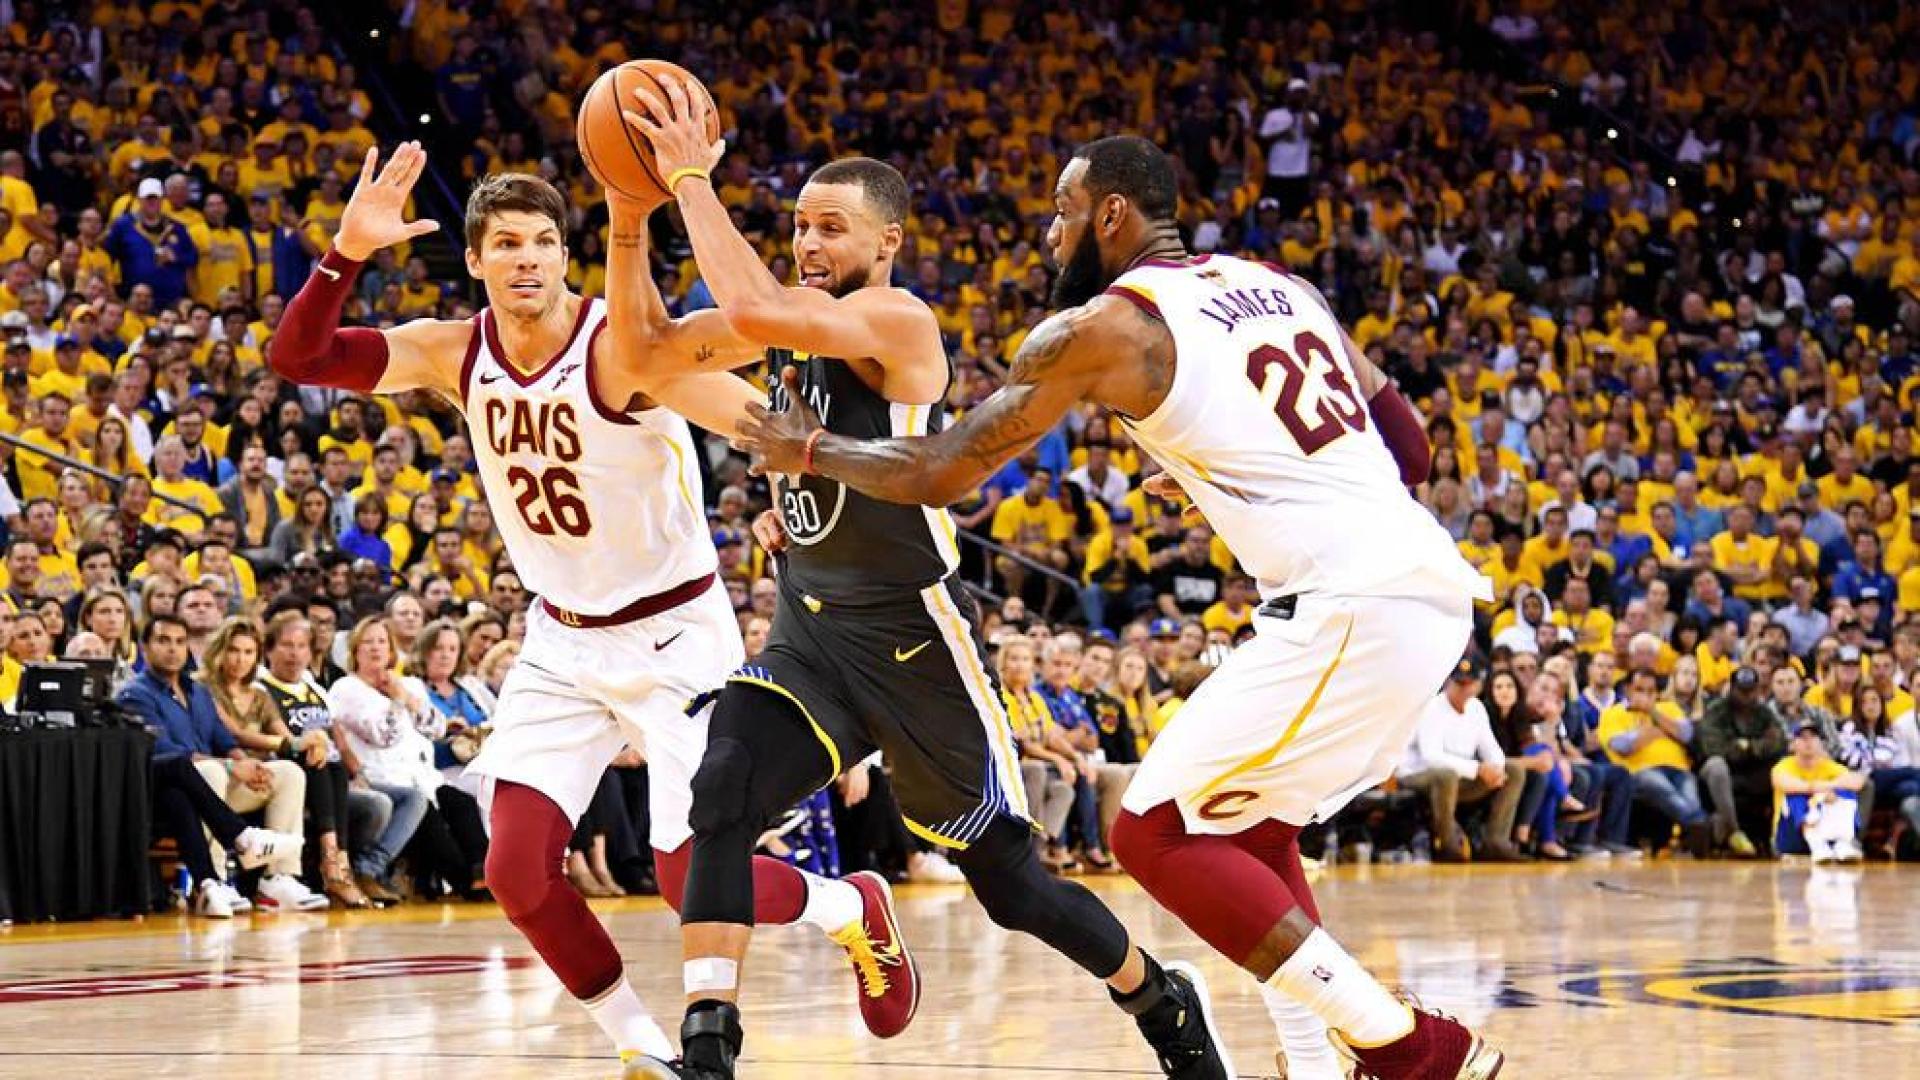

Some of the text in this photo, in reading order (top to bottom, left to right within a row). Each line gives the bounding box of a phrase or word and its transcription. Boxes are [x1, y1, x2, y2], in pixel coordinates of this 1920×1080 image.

[1200, 289, 1294, 332] JAMES
[1247, 331, 1366, 456] 23
[507, 466, 592, 537] 26
[785, 490, 821, 533] 30
